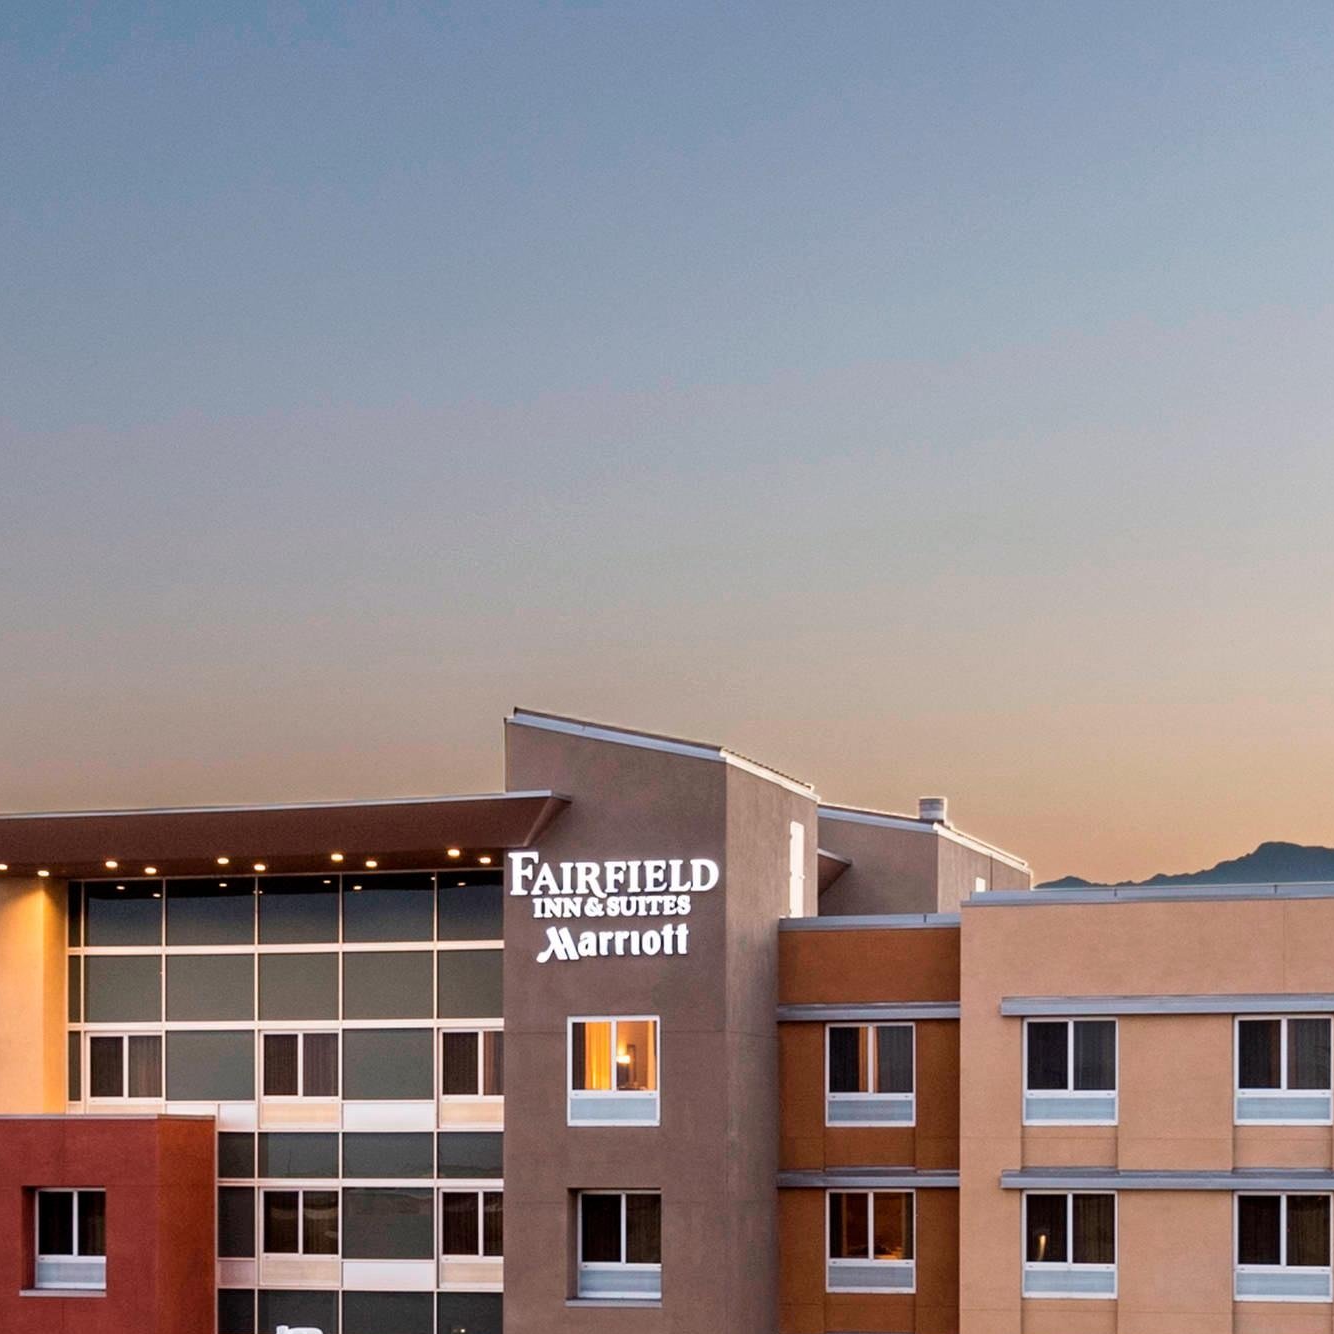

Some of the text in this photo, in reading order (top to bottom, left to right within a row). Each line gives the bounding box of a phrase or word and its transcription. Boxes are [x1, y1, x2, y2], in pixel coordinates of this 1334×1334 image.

[507, 851, 720, 899] FAIRFIELD
[532, 897, 583, 918] INN
[606, 894, 692, 917] SUITES
[535, 923, 690, 964] Marriott
